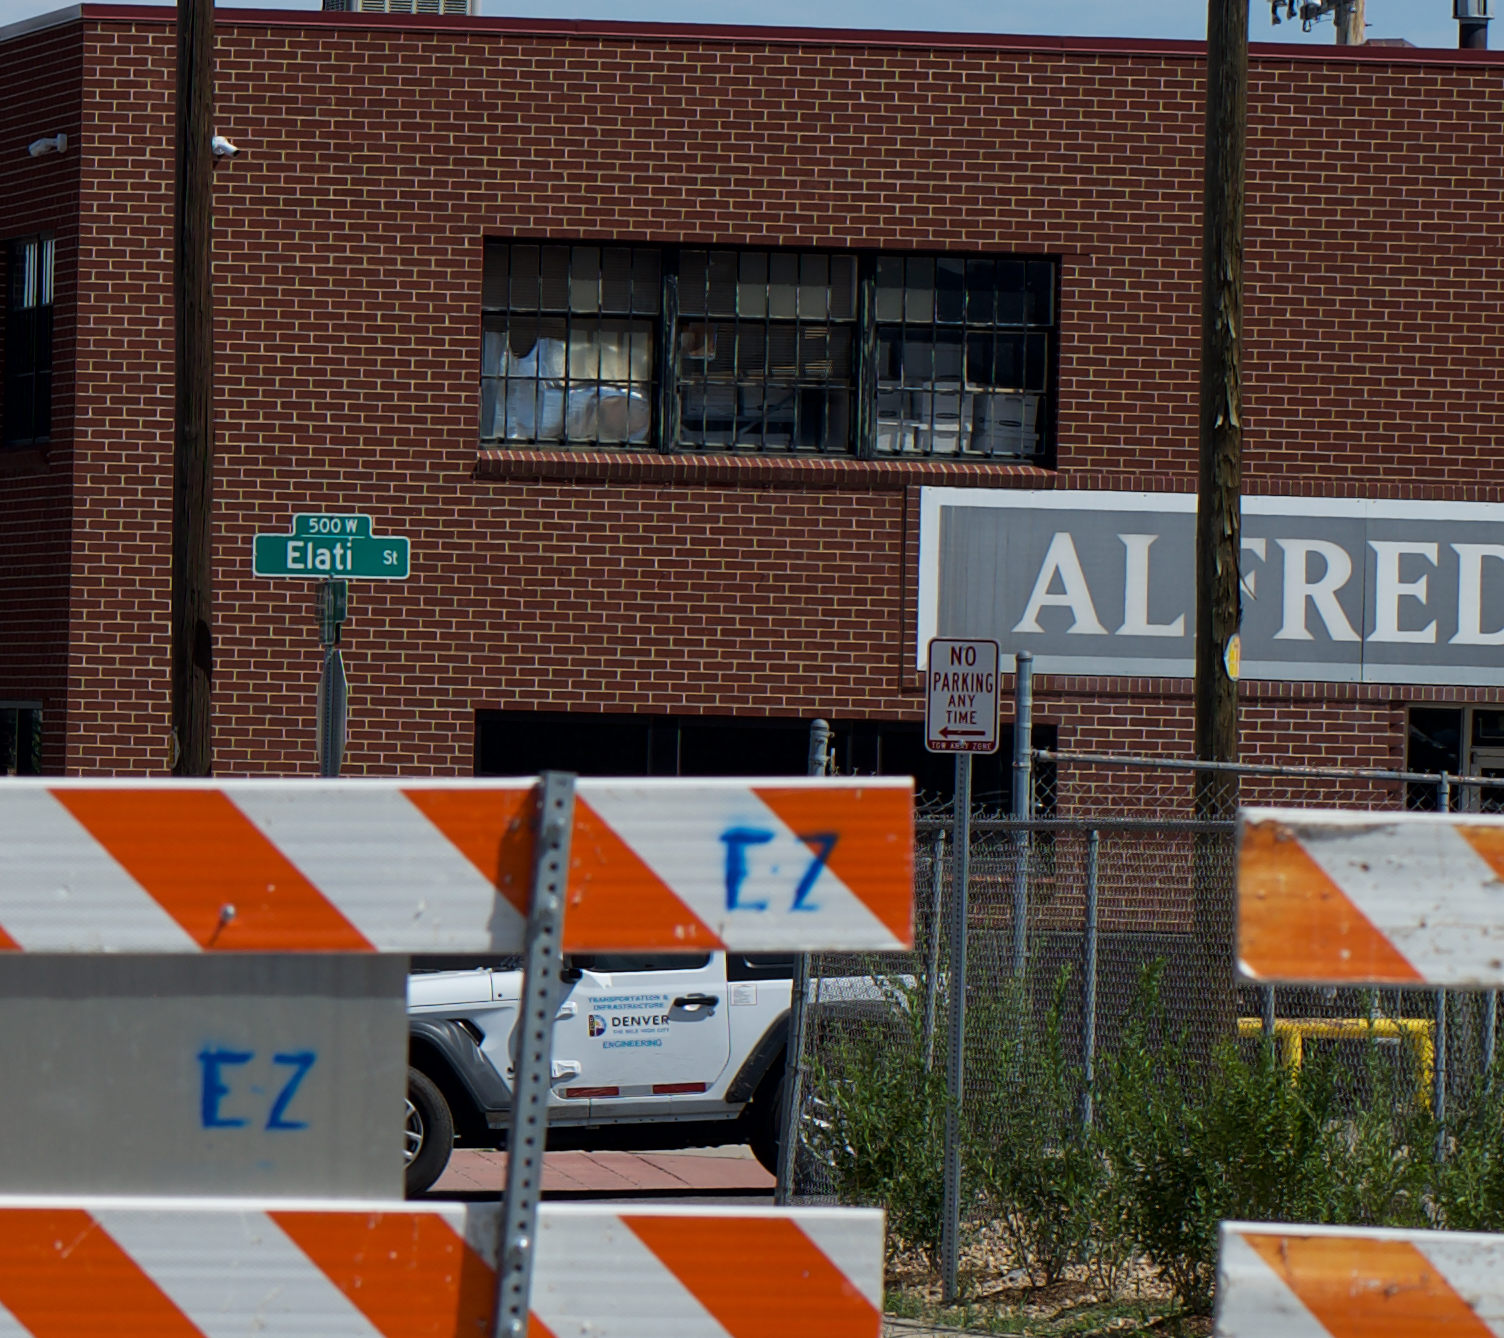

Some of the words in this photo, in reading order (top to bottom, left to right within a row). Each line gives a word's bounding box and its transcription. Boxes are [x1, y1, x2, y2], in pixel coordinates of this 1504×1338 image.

[308, 518, 342, 534] 500
[344, 518, 358, 534] W
[286, 539, 353, 571] Elati
[382, 550, 399, 566] St
[949, 645, 977, 667] NO
[933, 671, 993, 693] PARKING
[947, 693, 976, 708] ANY
[945, 710, 977, 725] TIME
[611, 1015, 670, 1027] DENVER
